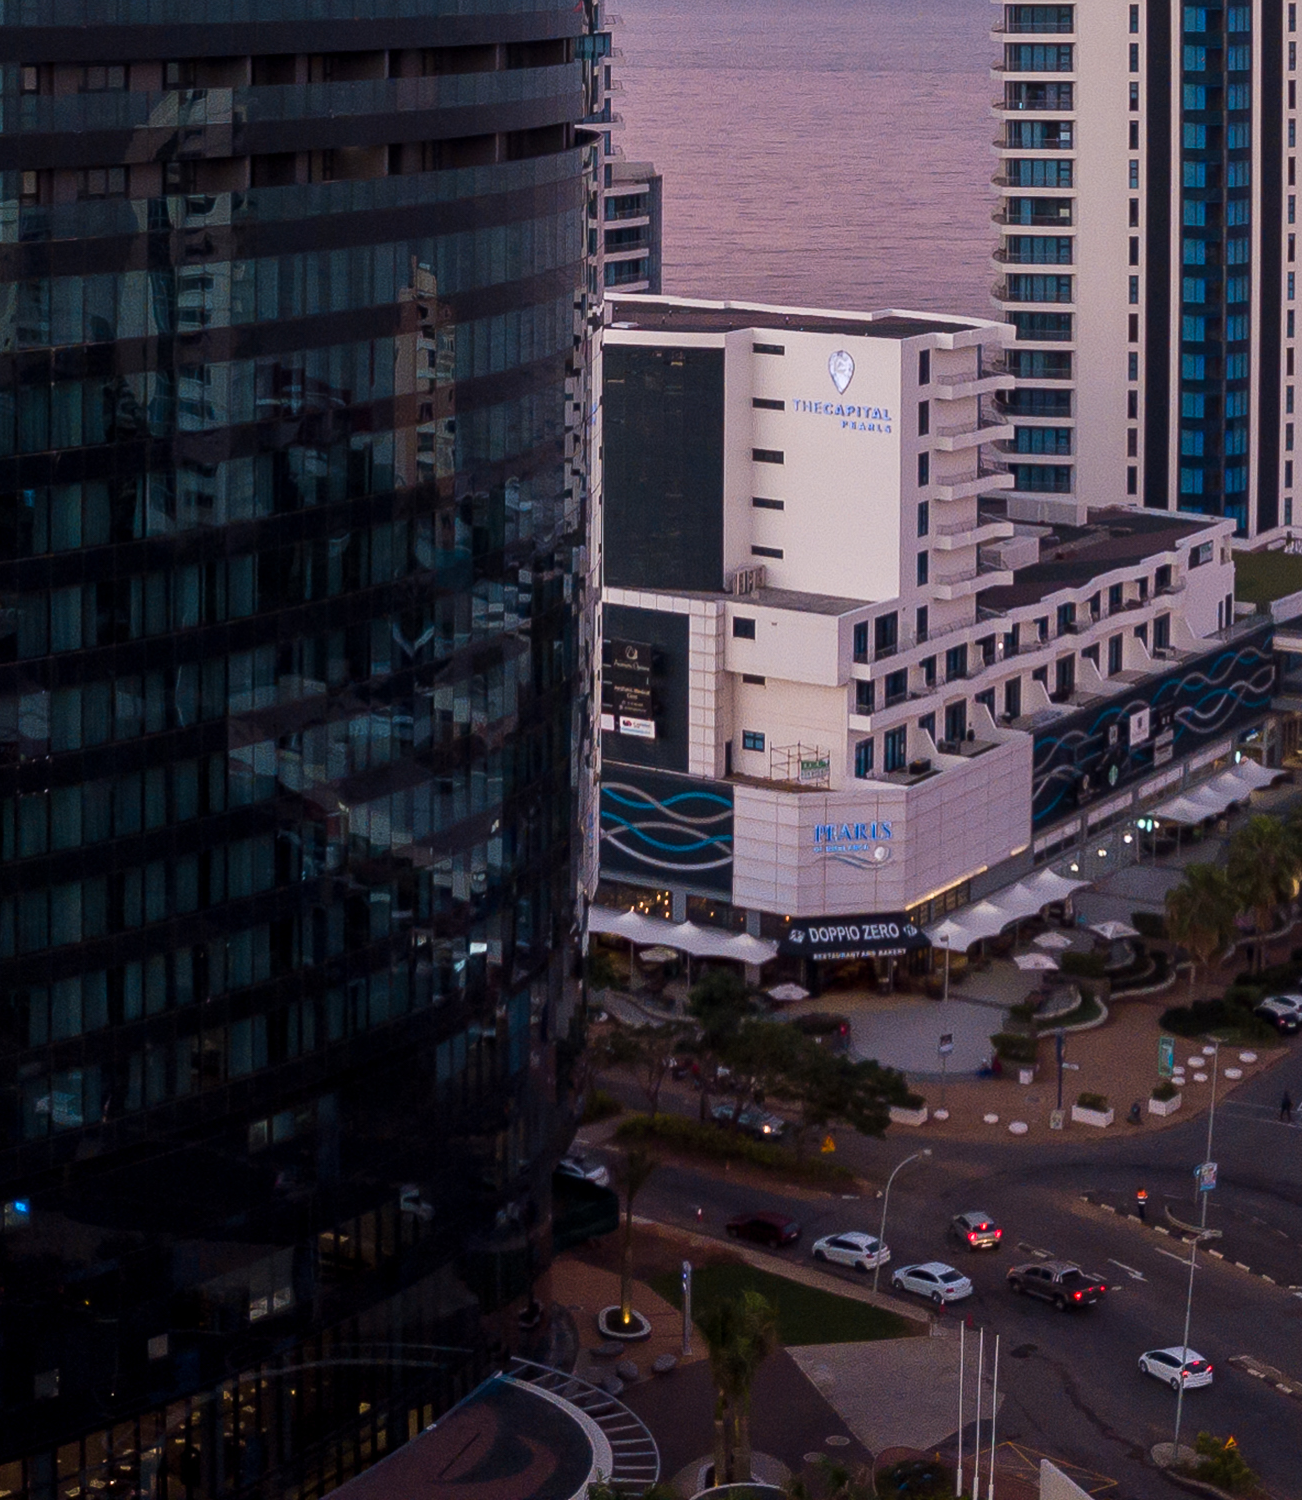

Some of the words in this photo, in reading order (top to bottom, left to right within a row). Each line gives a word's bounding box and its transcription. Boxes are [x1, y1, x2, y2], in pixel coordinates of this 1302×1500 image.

[841, 420, 892, 434] PEARLS
[814, 820, 892, 843] PEARLS
[808, 925, 859, 943] DOPPIO
[862, 923, 899, 940] ZERO
[813, 951, 859, 960] RESTAURANT
